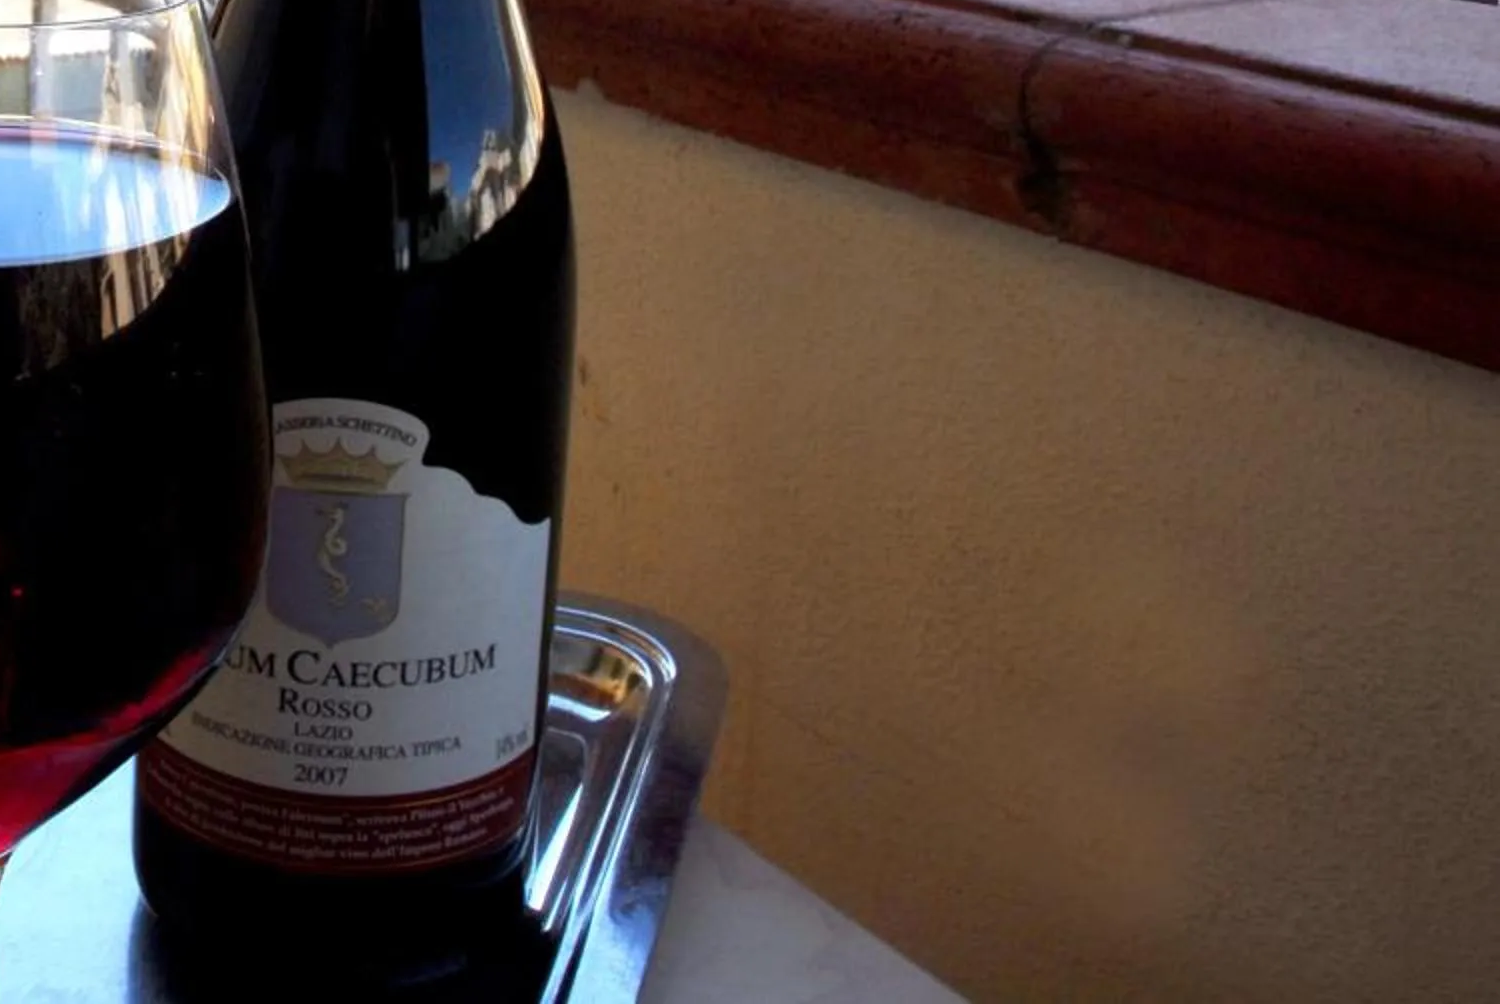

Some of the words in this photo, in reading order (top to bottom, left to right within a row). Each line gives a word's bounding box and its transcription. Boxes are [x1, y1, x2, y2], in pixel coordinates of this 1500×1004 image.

[336, 414, 418, 447] SCHETTINO
[225, 644, 276, 677] UM
[286, 643, 497, 690] CAECUBUM
[277, 687, 373, 721] ROSSO
[191, 711, 291, 754] INDICAZIONE
[293, 740, 407, 760] GEOGRAFICA
[411, 734, 462, 758] TIPICA
[293, 722, 353, 741] LAZIO
[293, 763, 349, 786] 2007
